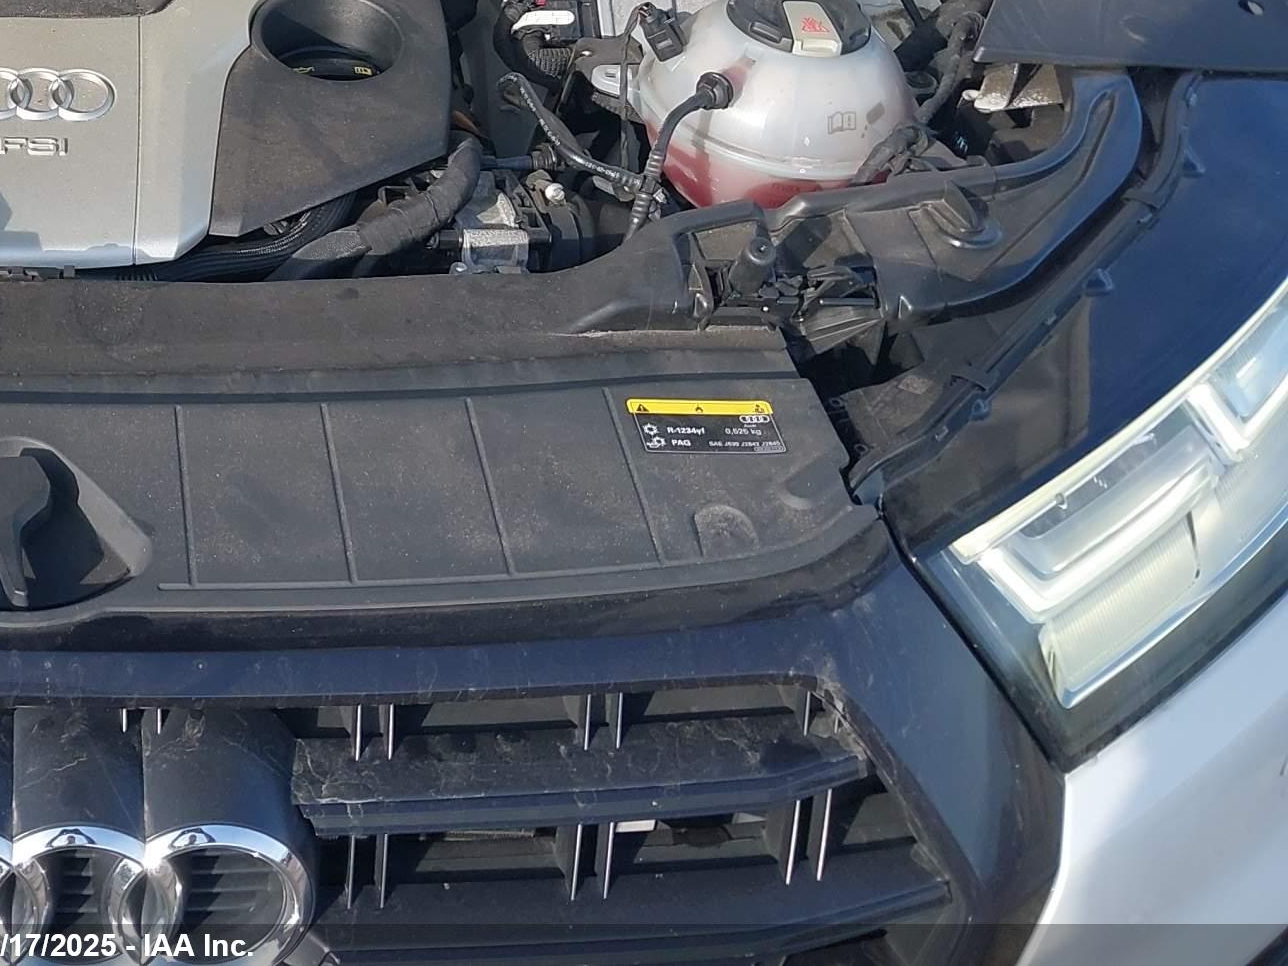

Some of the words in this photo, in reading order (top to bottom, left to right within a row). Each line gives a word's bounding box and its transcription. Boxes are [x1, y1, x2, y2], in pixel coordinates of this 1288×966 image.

[666, 426, 706, 435] R-1234yf
[750, 428, 762, 436] kg
[671, 439, 692, 447] PAG
